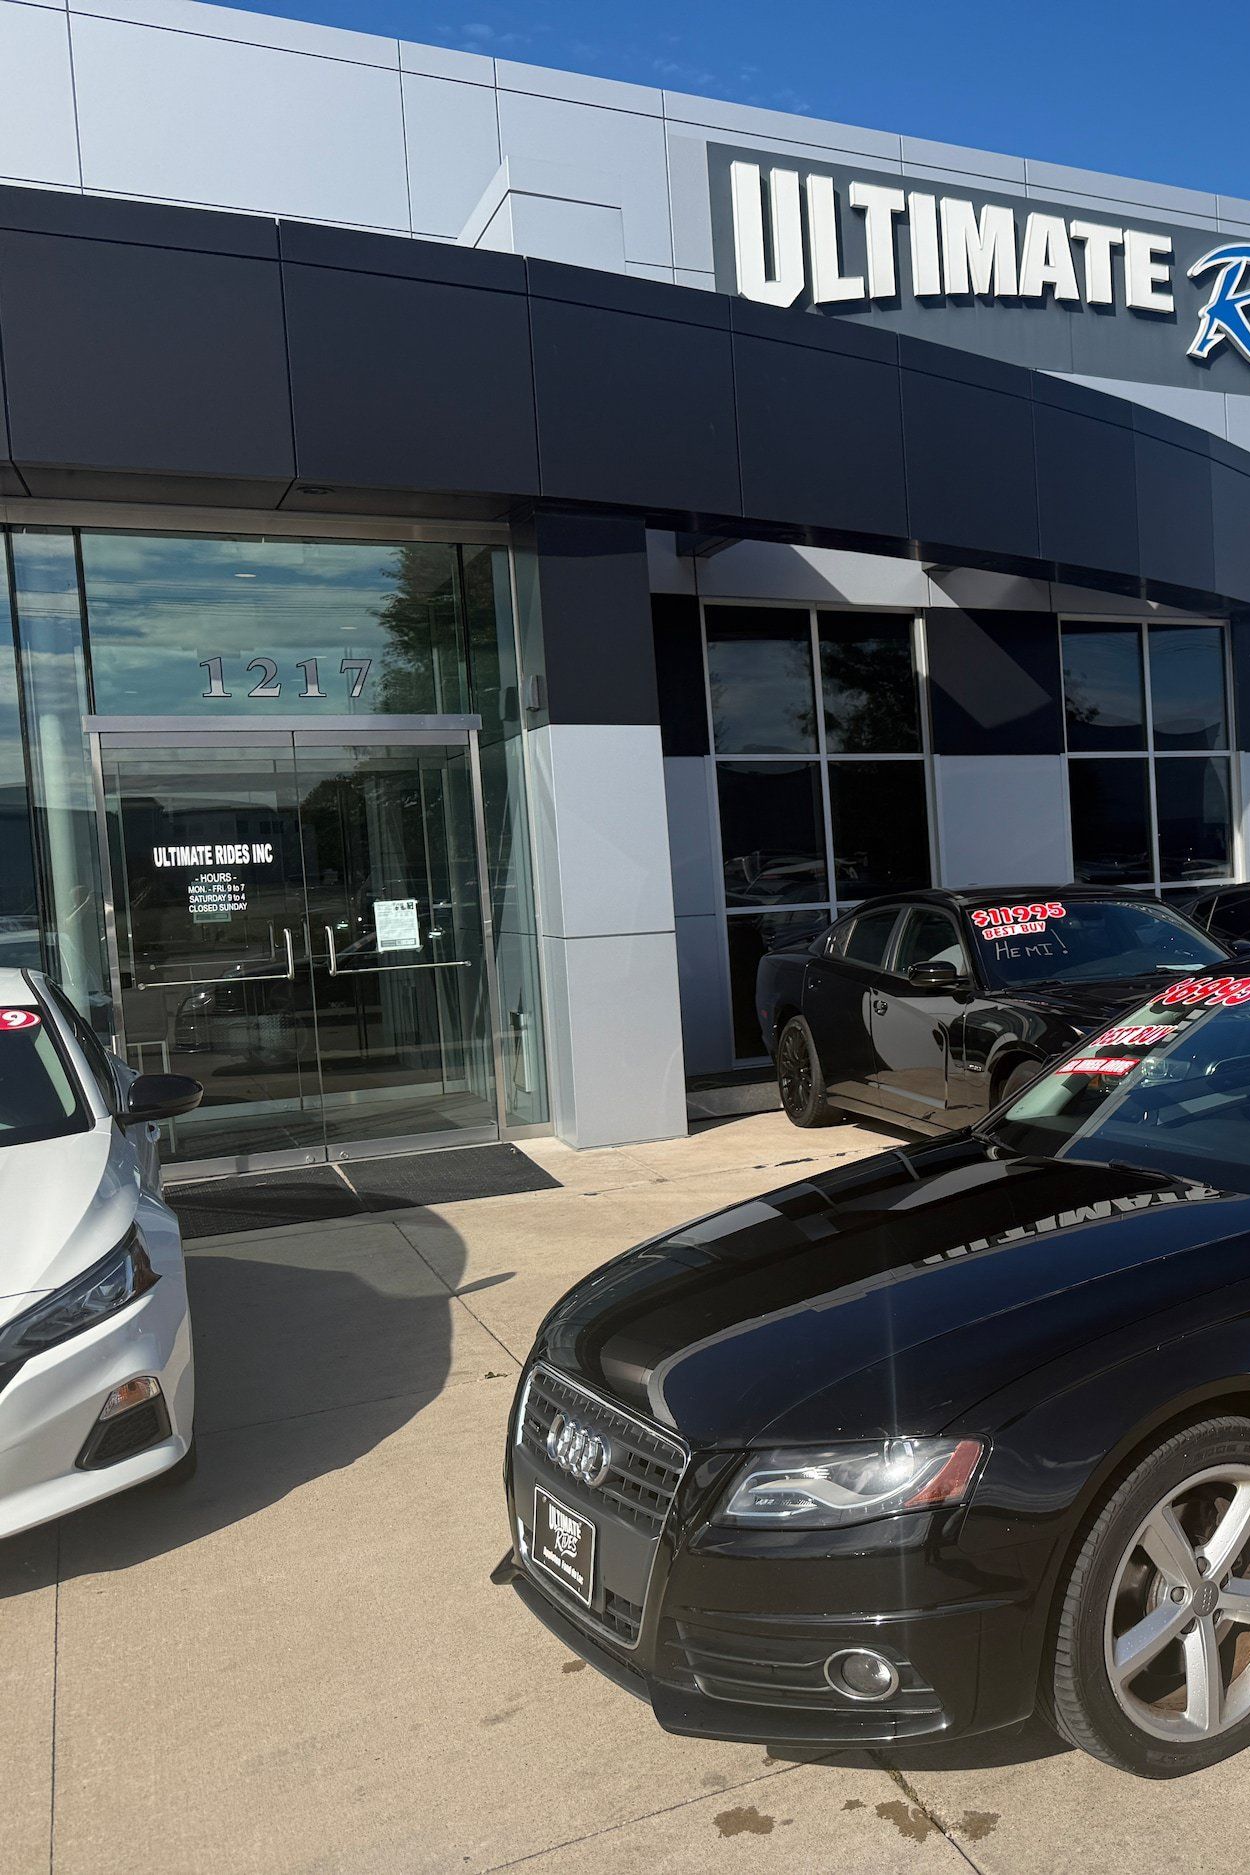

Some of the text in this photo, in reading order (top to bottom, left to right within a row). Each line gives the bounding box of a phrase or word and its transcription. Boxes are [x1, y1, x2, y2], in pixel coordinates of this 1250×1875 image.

[730, 160, 1175, 312] ULTIMATE
[199, 656, 372, 698] 1217
[153, 843, 273, 867] ULTIMATE RIDES INC
[188, 885, 207, 894] MON.
[213, 885, 225, 893] FRI.
[227, 885, 232, 893] 9
[241, 884, 245, 892] 7
[200, 873, 232, 882] HOURS
[188, 902, 248, 913] CLOSED SUNDAY
[189, 894, 226, 903] SATURDAY
[240, 893, 245, 901] 4
[971, 902, 1066, 927] $11995
[983, 921, 1046, 940] BEST BUY
[1090, 1024, 1178, 1048] BEST BUY
[549, 1503, 582, 1540] ULTIMATE
